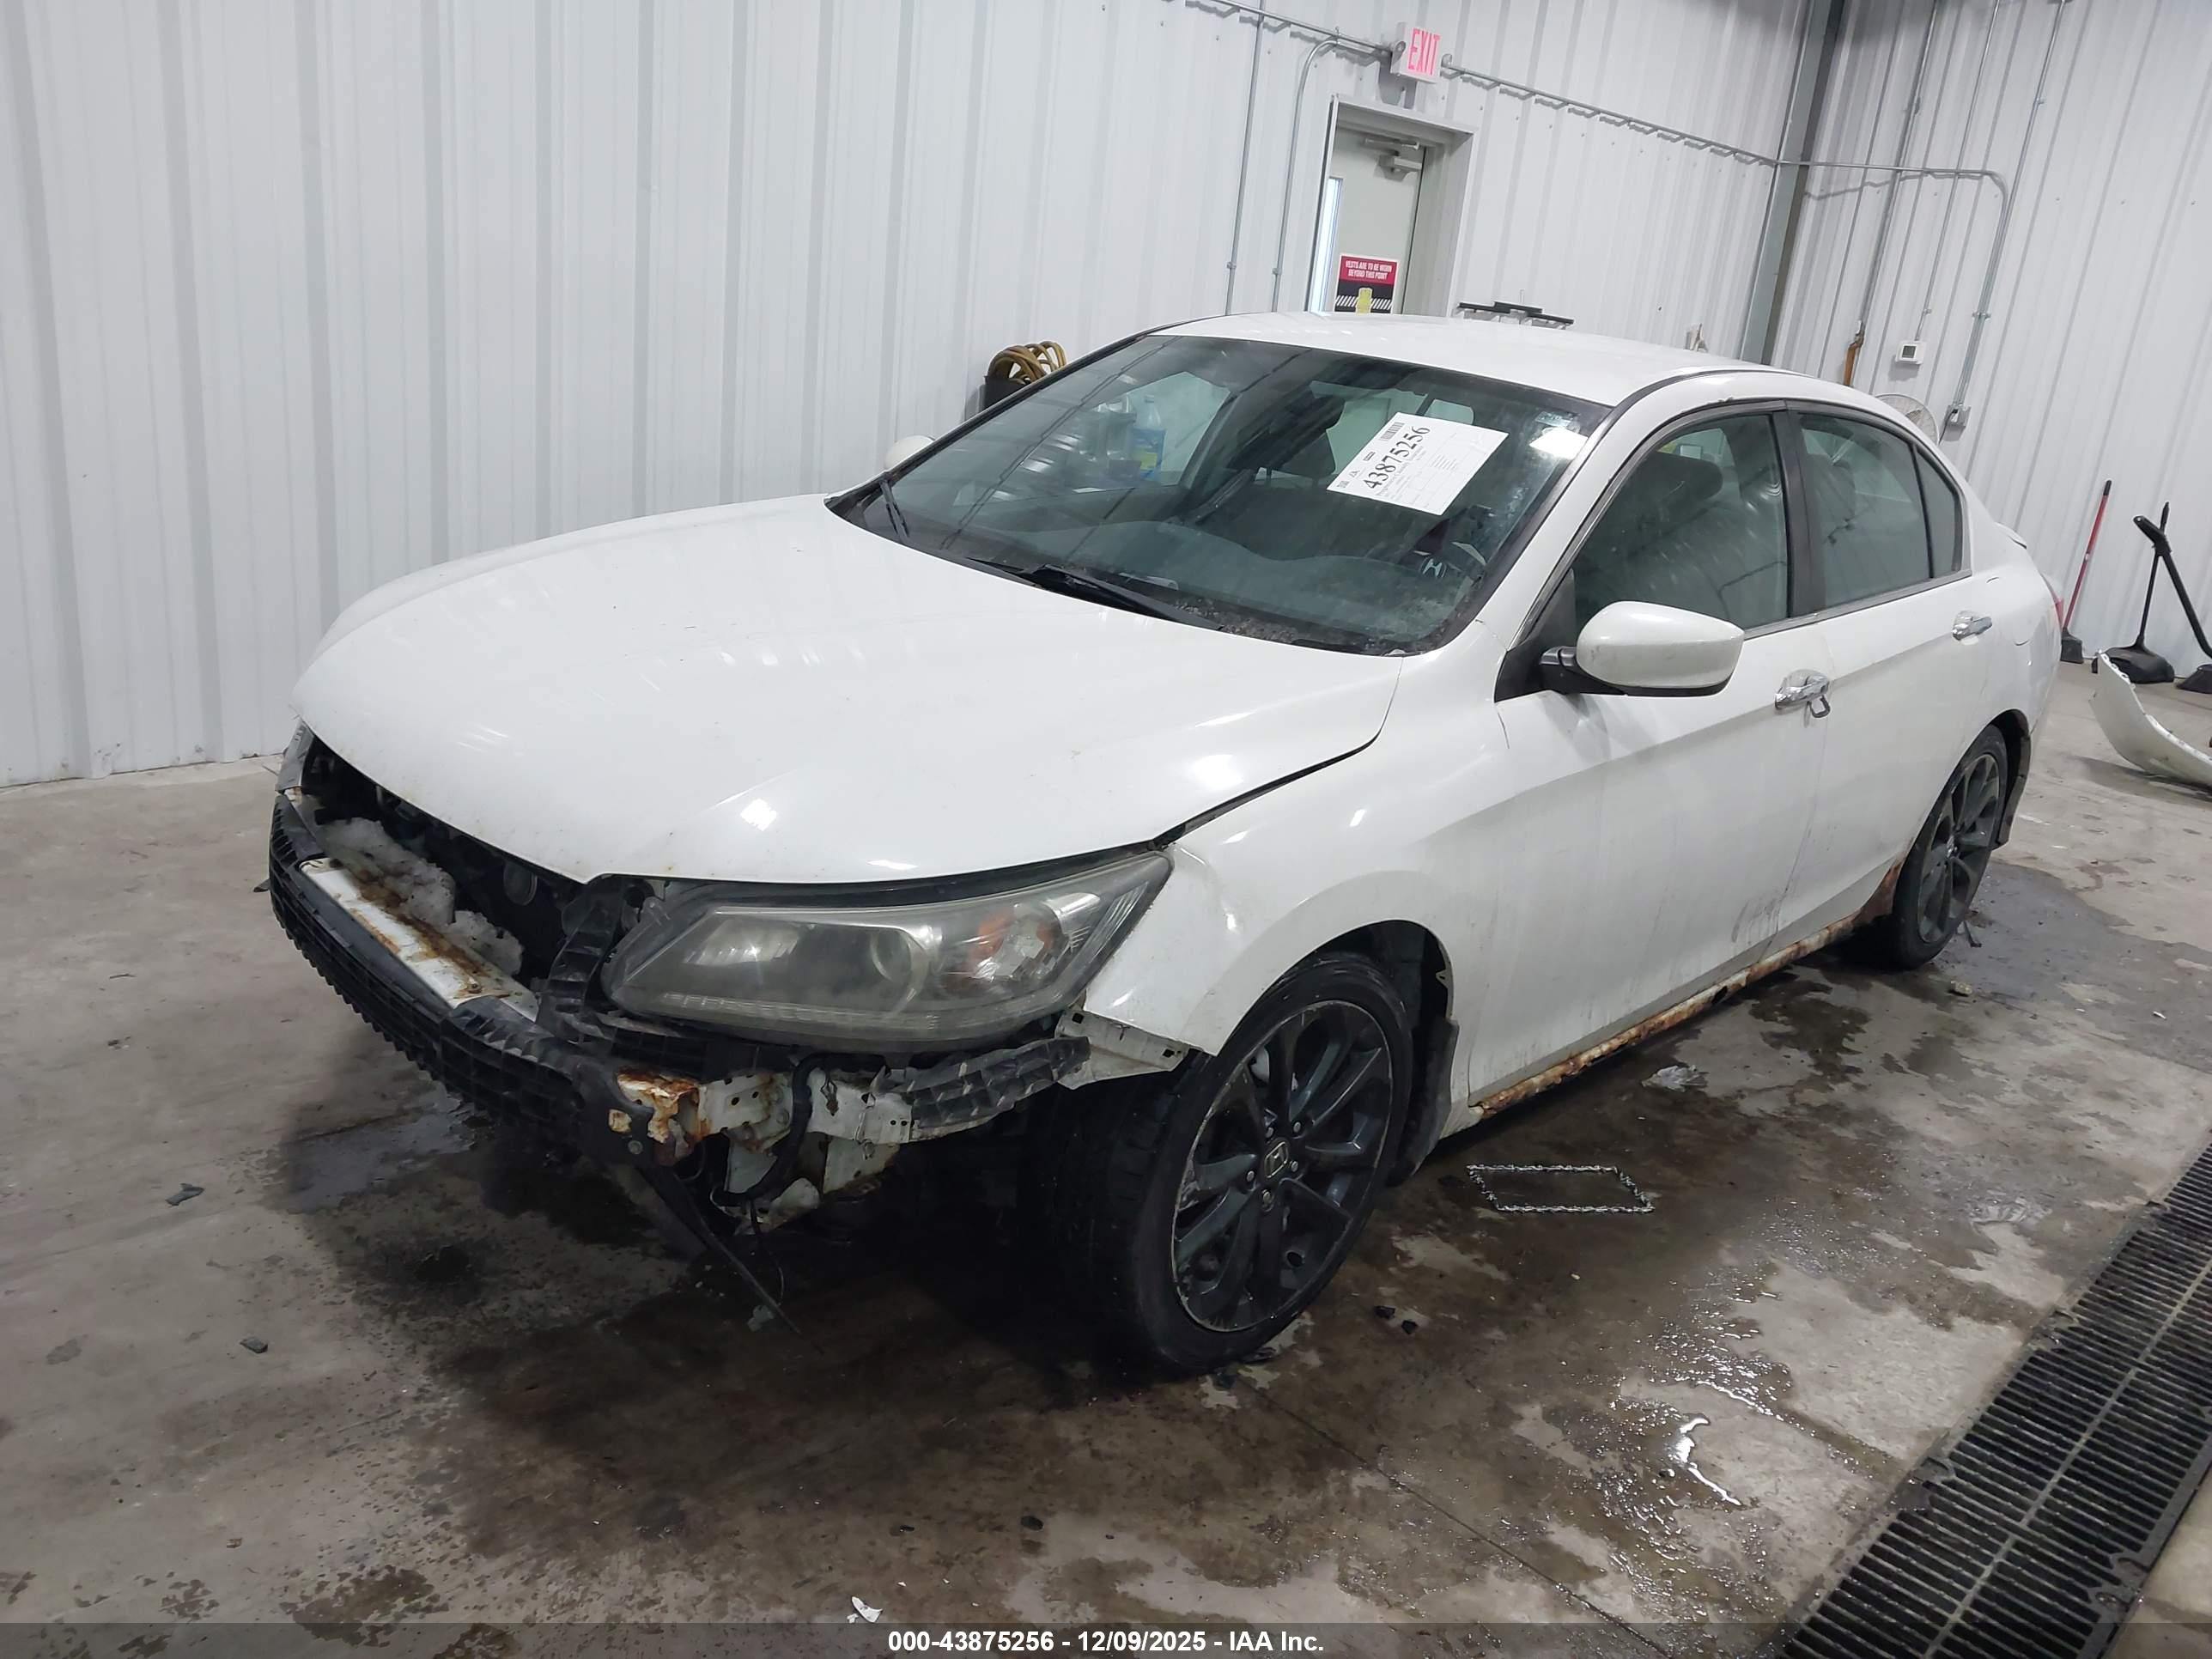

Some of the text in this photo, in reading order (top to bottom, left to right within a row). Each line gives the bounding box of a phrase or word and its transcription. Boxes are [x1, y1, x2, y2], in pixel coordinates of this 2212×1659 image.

[1408, 27, 1441, 76] EXIT
[1368, 262, 1374, 270] TO
[1364, 426, 1430, 489] 43875256
